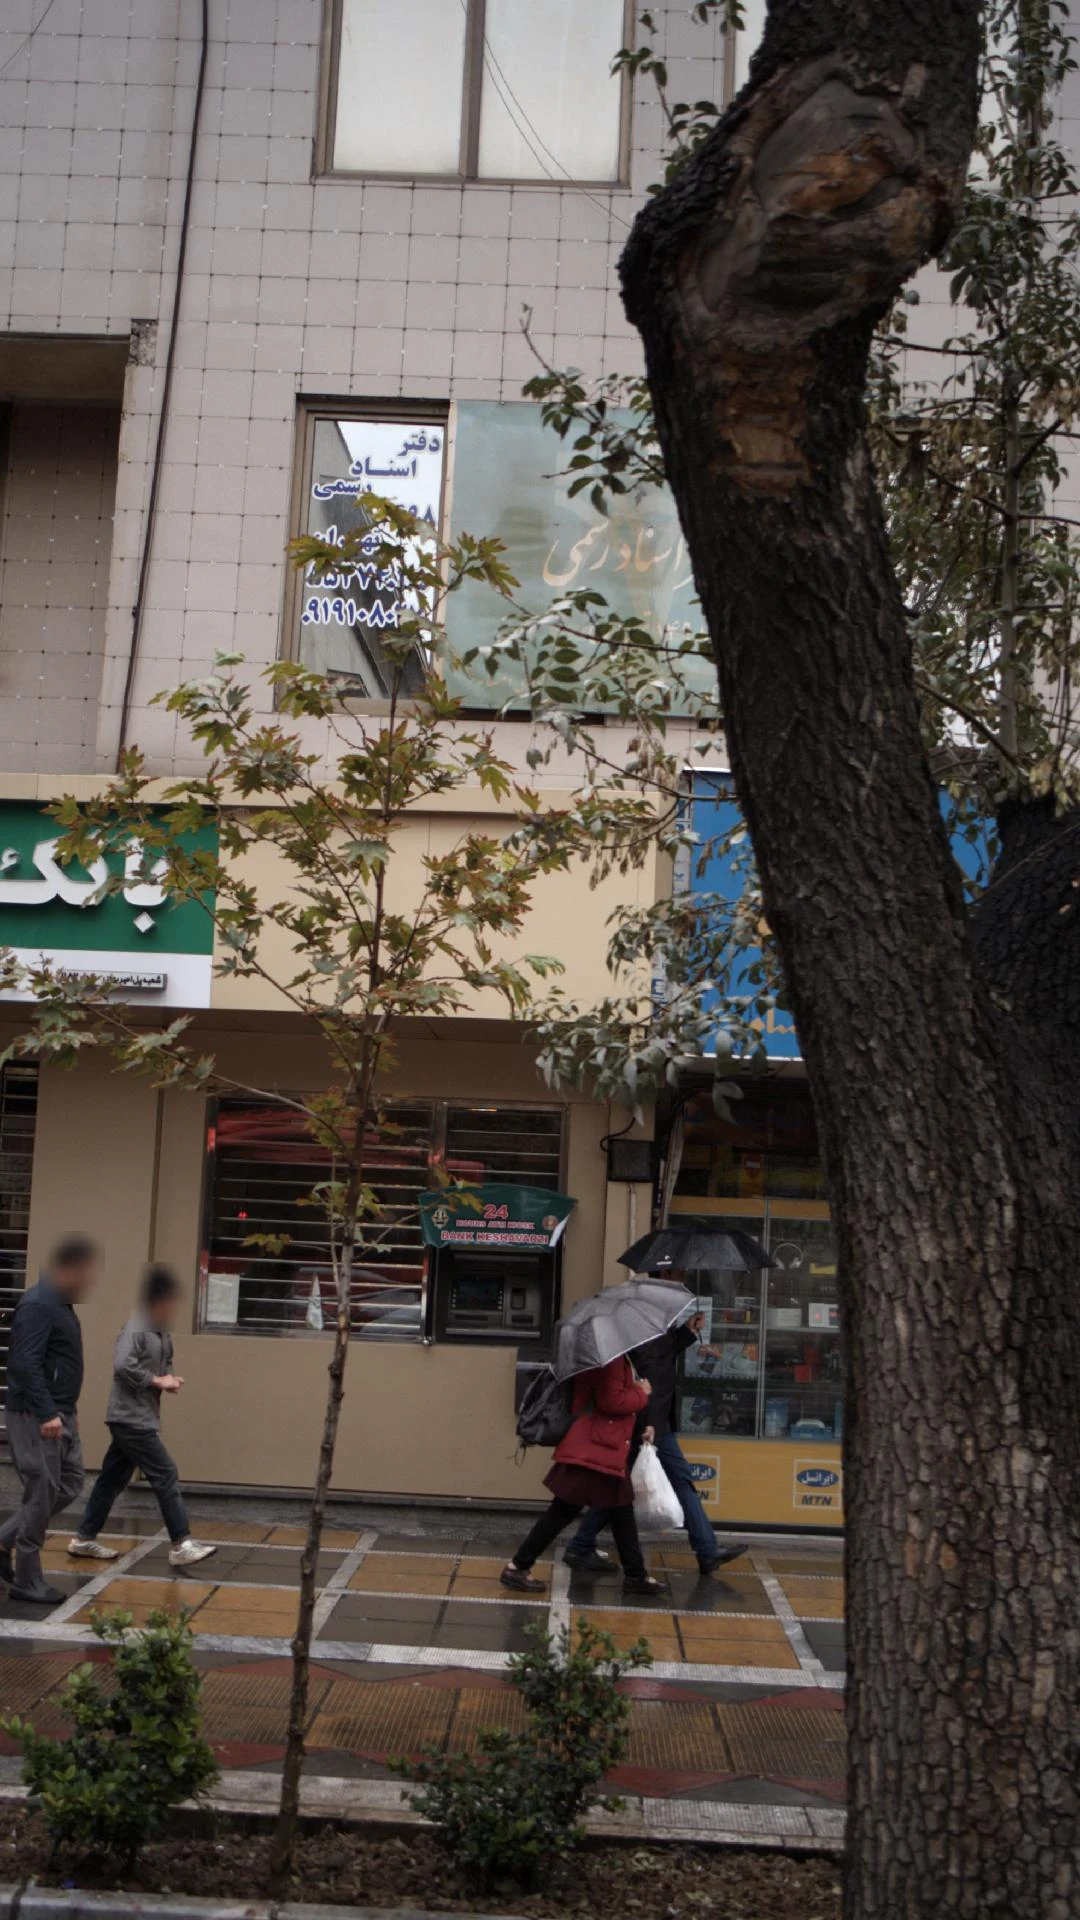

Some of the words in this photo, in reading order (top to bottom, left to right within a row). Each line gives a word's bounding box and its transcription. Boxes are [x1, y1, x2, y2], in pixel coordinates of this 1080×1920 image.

[397, 430, 440, 456] دفتر
[351, 456, 418, 479] اسناد
[313, 479, 373, 499] رسمی
[543, 519, 610, 587] رسمی
[614, 527, 684, 573] اسناد
[143, 975, 162, 985] شعبه
[484, 1204, 509, 1219] 24
[441, 1230, 474, 1241] BANK
[476, 1231, 549, 1245] KESHAVARZI
[801, 1470, 835, 1486] ایرانسل
[801, 1494, 833, 1507] MTN
